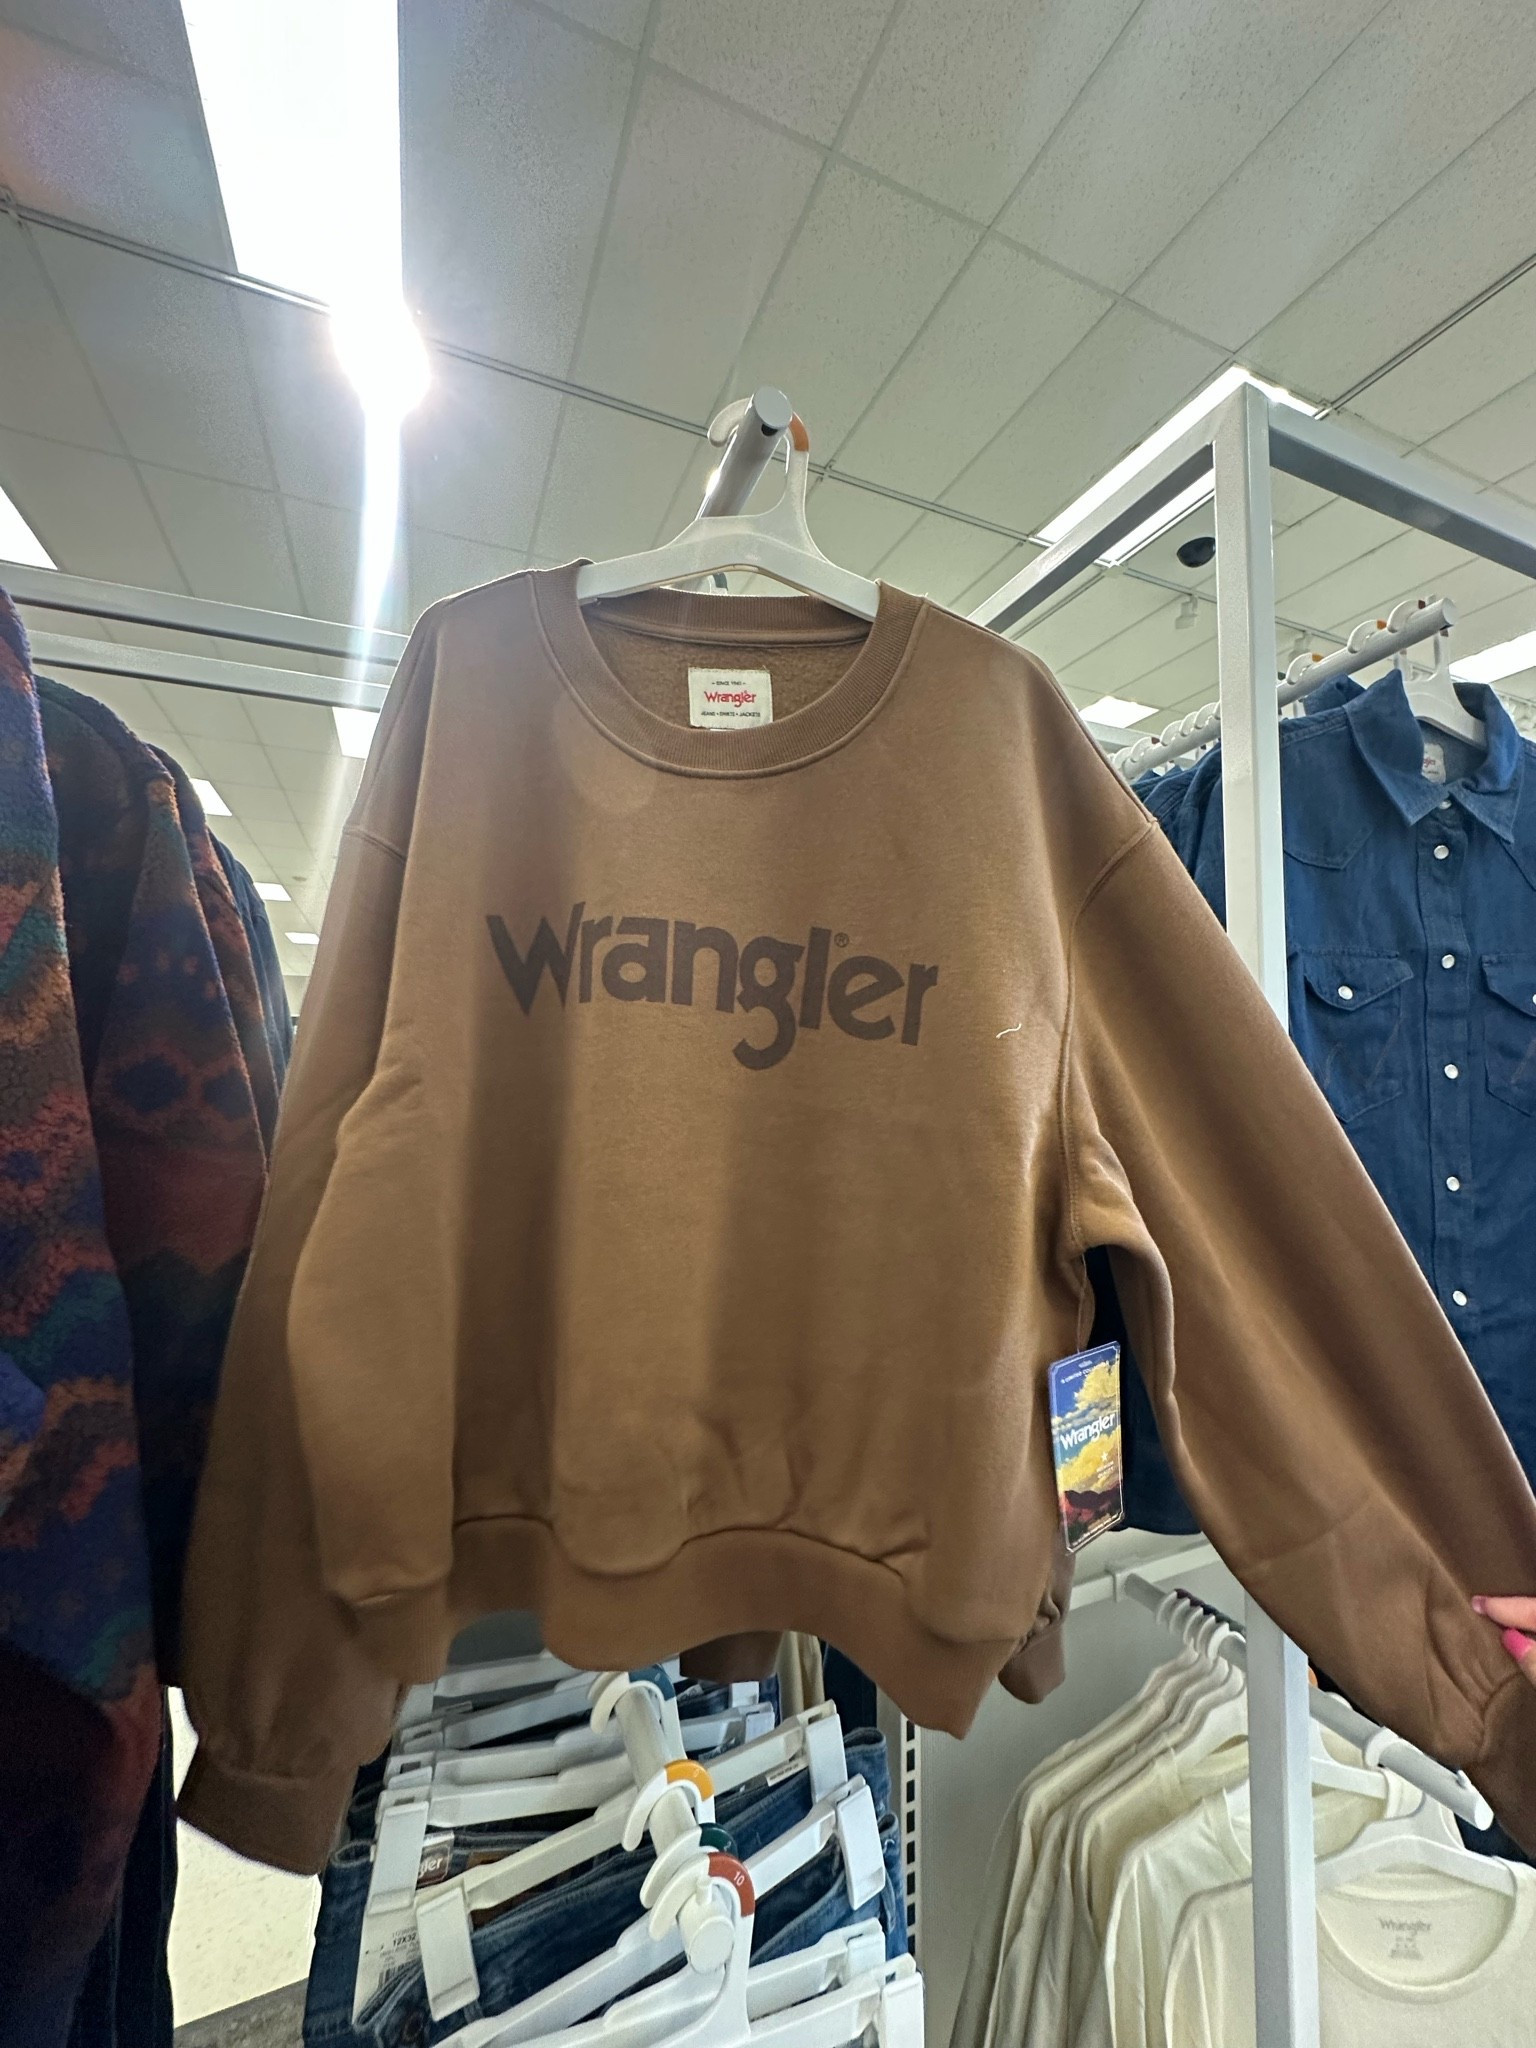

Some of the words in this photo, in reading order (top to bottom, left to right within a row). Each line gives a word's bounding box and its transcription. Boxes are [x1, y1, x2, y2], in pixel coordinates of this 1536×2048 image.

[704, 690, 756, 708] Wrangler
[485, 901, 939, 1071] Wrangler
[1060, 1413, 1115, 1450] Wrangler
[733, 1871, 745, 1887] 10
[1379, 1917, 1431, 1937] Wrangler
